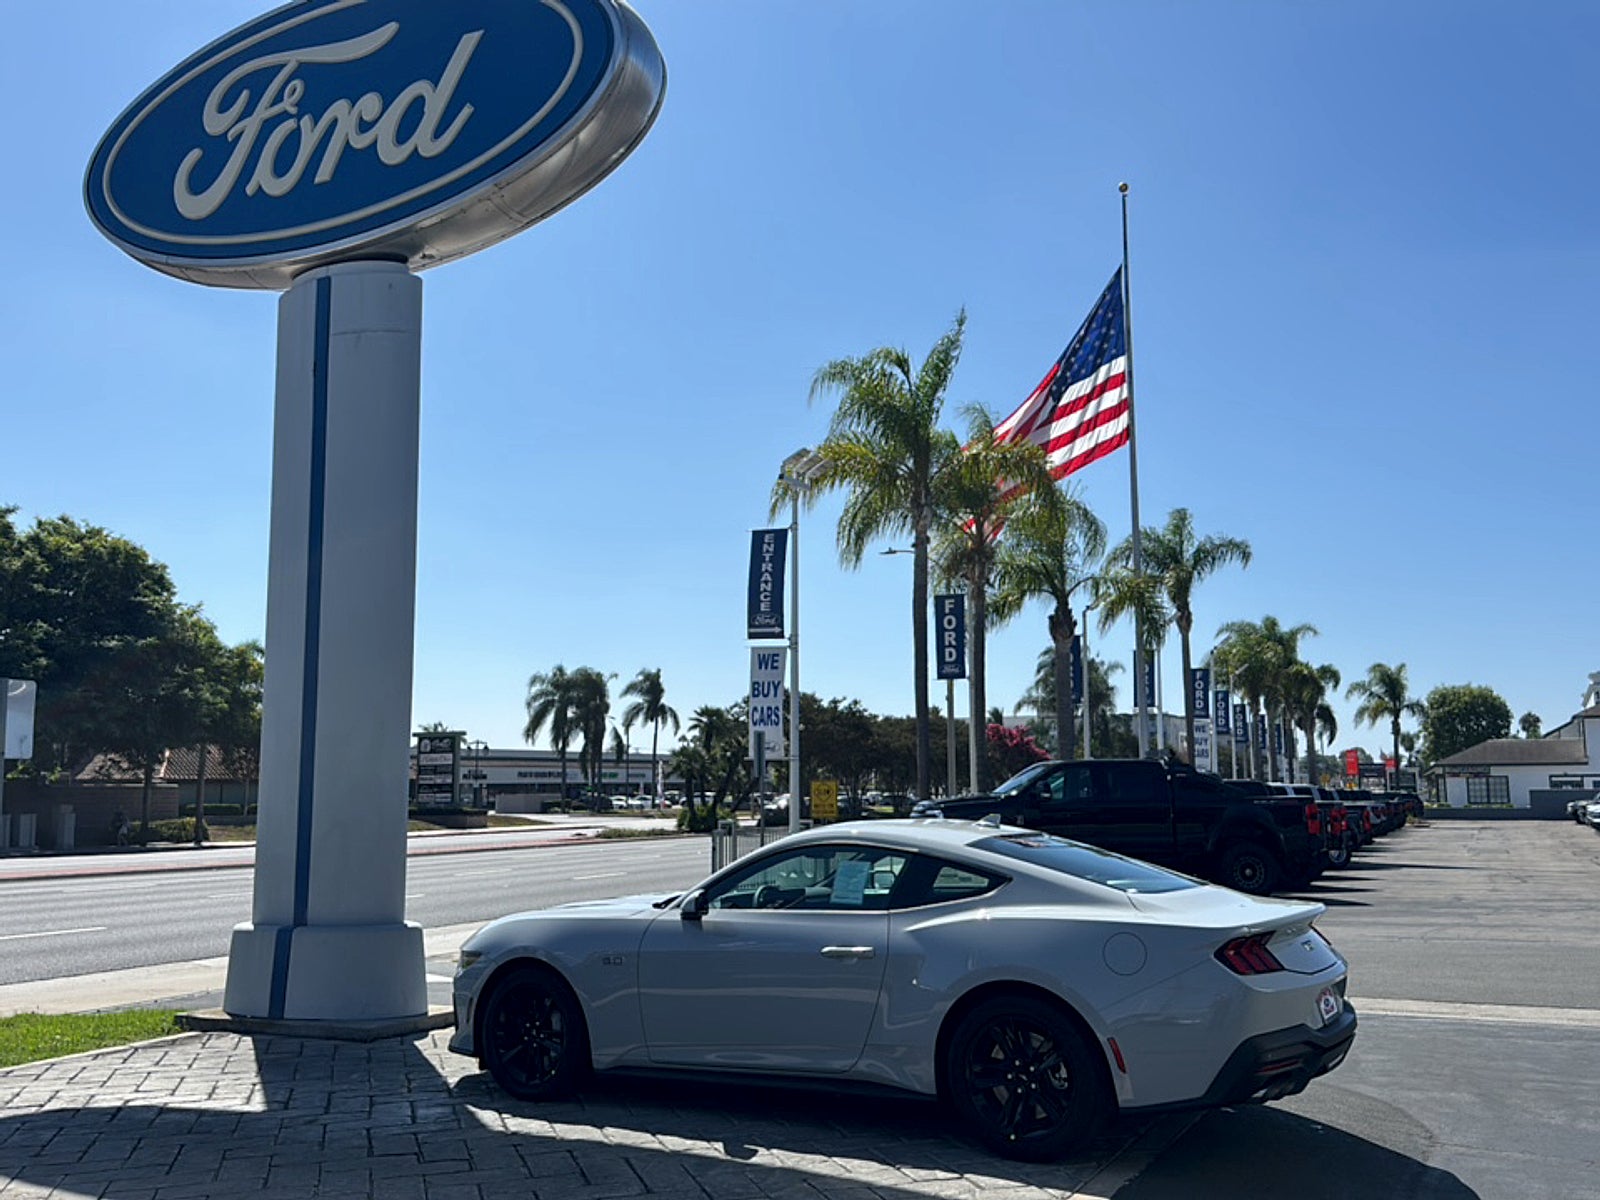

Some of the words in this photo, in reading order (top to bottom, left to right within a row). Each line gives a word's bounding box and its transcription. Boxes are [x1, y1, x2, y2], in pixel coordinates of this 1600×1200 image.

[173, 21, 484, 220] Ford
[760, 533, 774, 611] ENTRANCE
[943, 599, 957, 662] FORD
[757, 653, 780, 670] WE
[752, 681, 781, 698] BUY
[1194, 671, 1204, 708] FORD
[751, 706, 780, 727] CARS
[1216, 692, 1226, 725] FORD
